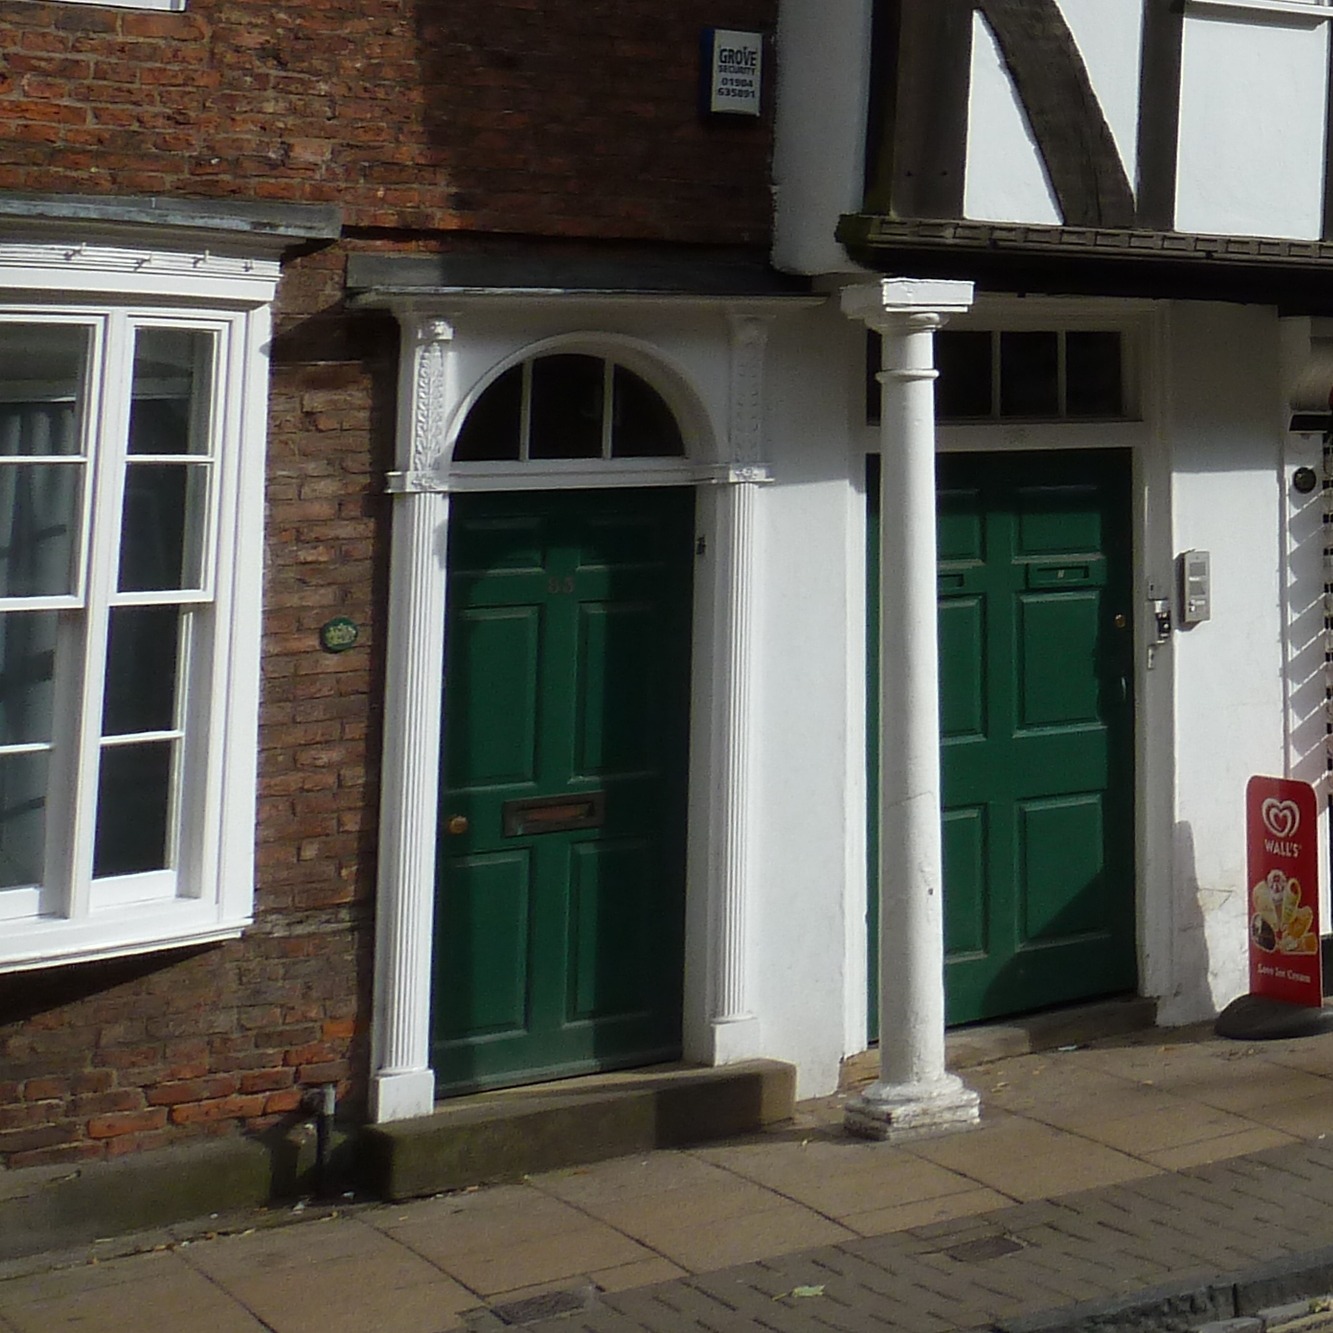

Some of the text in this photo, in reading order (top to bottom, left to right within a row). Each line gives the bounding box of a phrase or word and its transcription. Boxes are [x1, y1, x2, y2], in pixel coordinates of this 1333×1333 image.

[719, 48, 757, 66] GROVE
[718, 65, 756, 75] SECURITY
[721, 77, 753, 87] 01904
[1264, 838, 1299, 858] WALL'S
